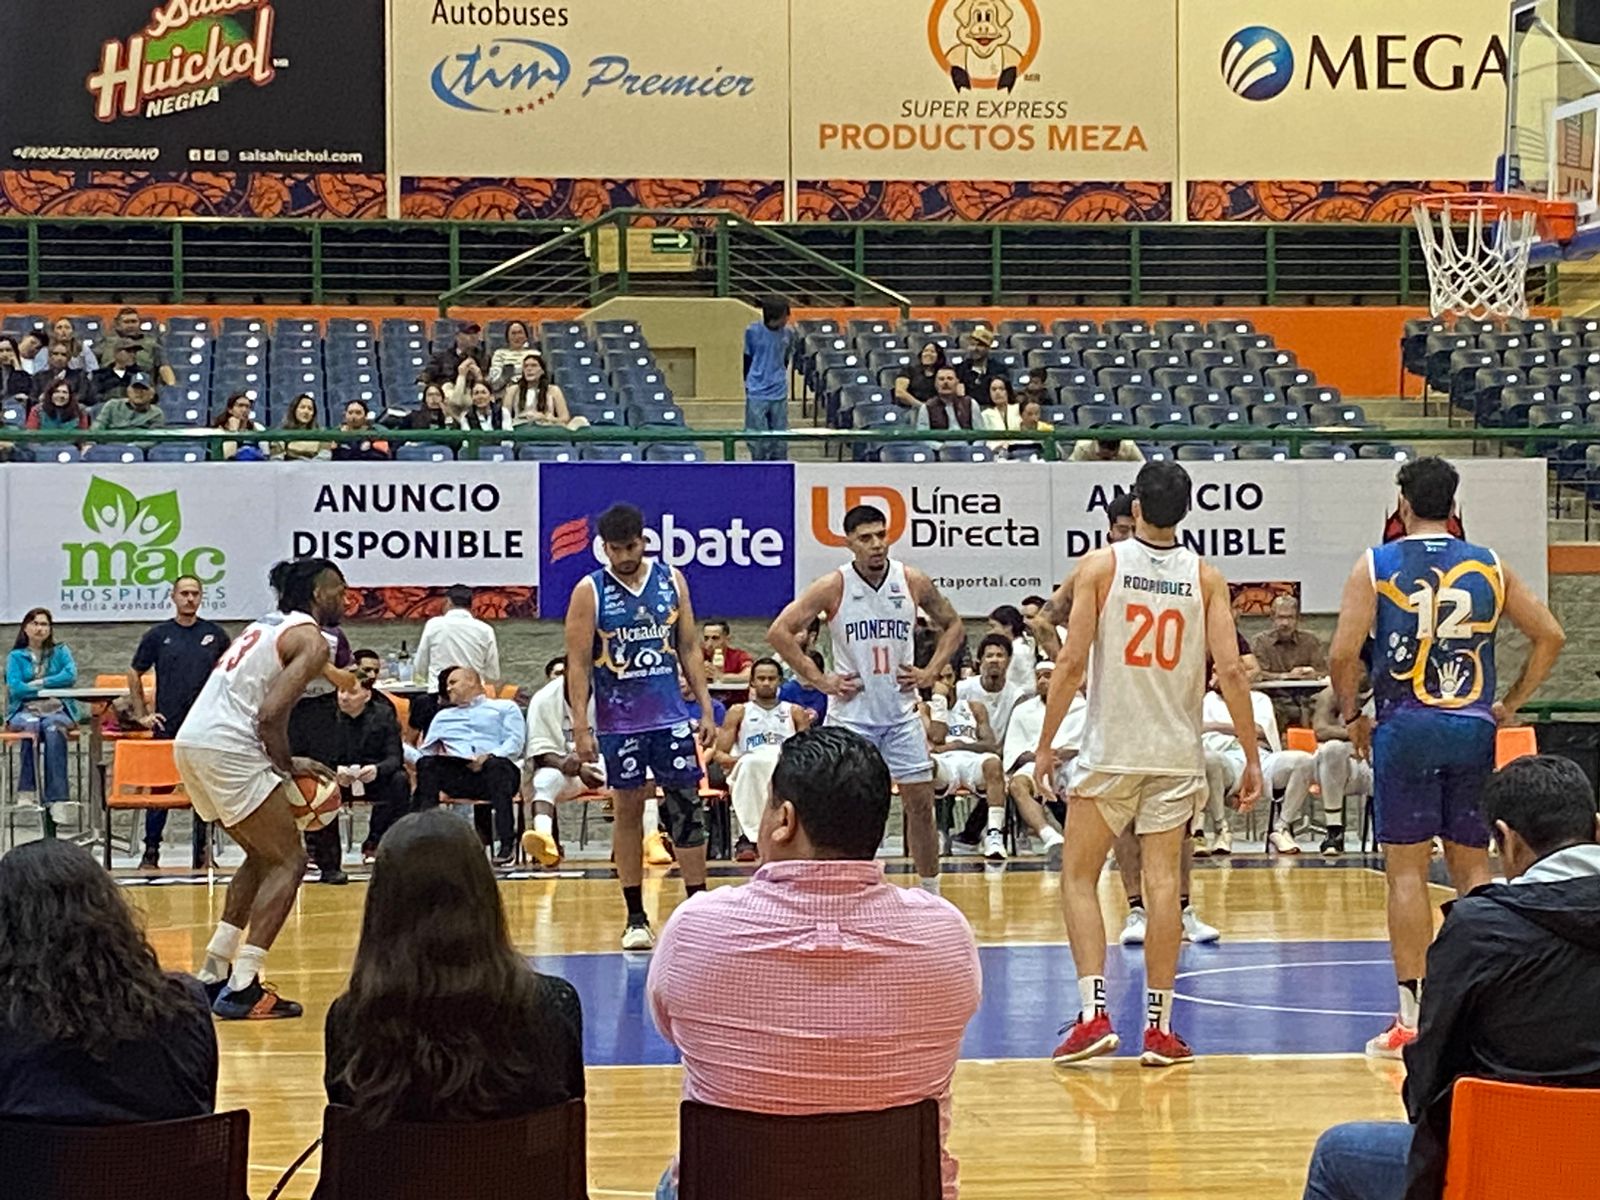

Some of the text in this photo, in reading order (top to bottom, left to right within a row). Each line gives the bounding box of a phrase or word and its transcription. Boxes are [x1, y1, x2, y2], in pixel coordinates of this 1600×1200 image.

[432, 0, 568, 26] Autobuses
[88, 7, 272, 120] Huichol
[581, 56, 755, 98] Premier
[1305, 34, 1507, 91] MEGA
[146, 86, 220, 118] NEGRA
[901, 100, 1068, 119] SUPER EXPRESS
[818, 123, 1148, 152] PRODUCTOS MEZA
[239, 149, 363, 163] salsahuichol.com
[313, 483, 501, 513] ANUNCIO
[911, 486, 1002, 514] Línea
[1086, 482, 1264, 513] ACIO
[292, 530, 524, 560] DISPONIBLE
[911, 518, 1040, 548] Directa
[1067, 528, 1287, 558] DINIBLE
[61, 540, 227, 588] mac
[60, 586, 227, 602] HOSPITAES
[1123, 575, 1193, 598] RODRIGUEZ
[1409, 587, 1473, 640] 12
[845, 619, 912, 645] PIONEROS
[1124, 603, 1185, 671] 20
[872, 645, 891, 675] 11
